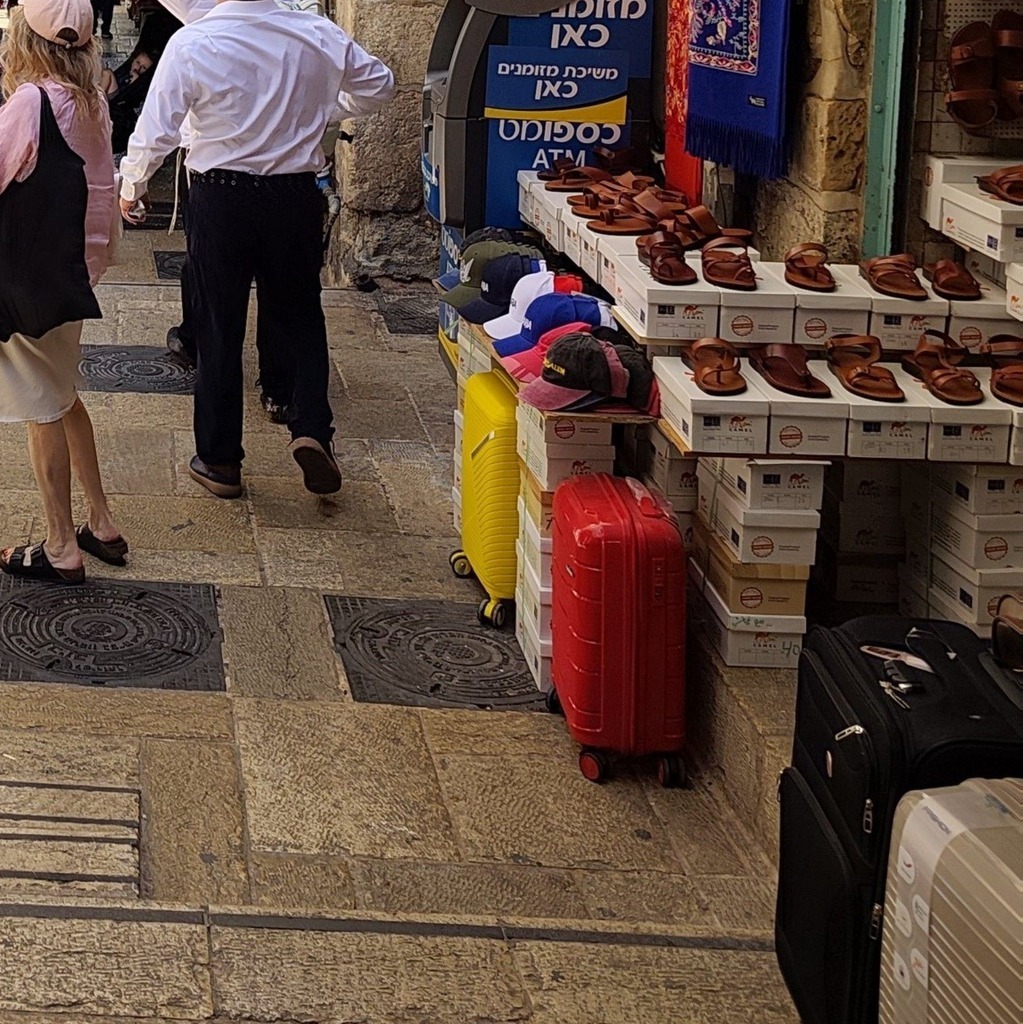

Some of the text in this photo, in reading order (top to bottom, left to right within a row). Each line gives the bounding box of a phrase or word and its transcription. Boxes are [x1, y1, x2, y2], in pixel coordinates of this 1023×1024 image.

[550, 23, 610, 49] כאן
[497, 63, 618, 80] משיכת מזומנים
[534, 79, 578, 100] כאן
[498, 119, 621, 145] כספומט
[532, 148, 586, 169] ATM
[781, 640, 800, 657] 40
